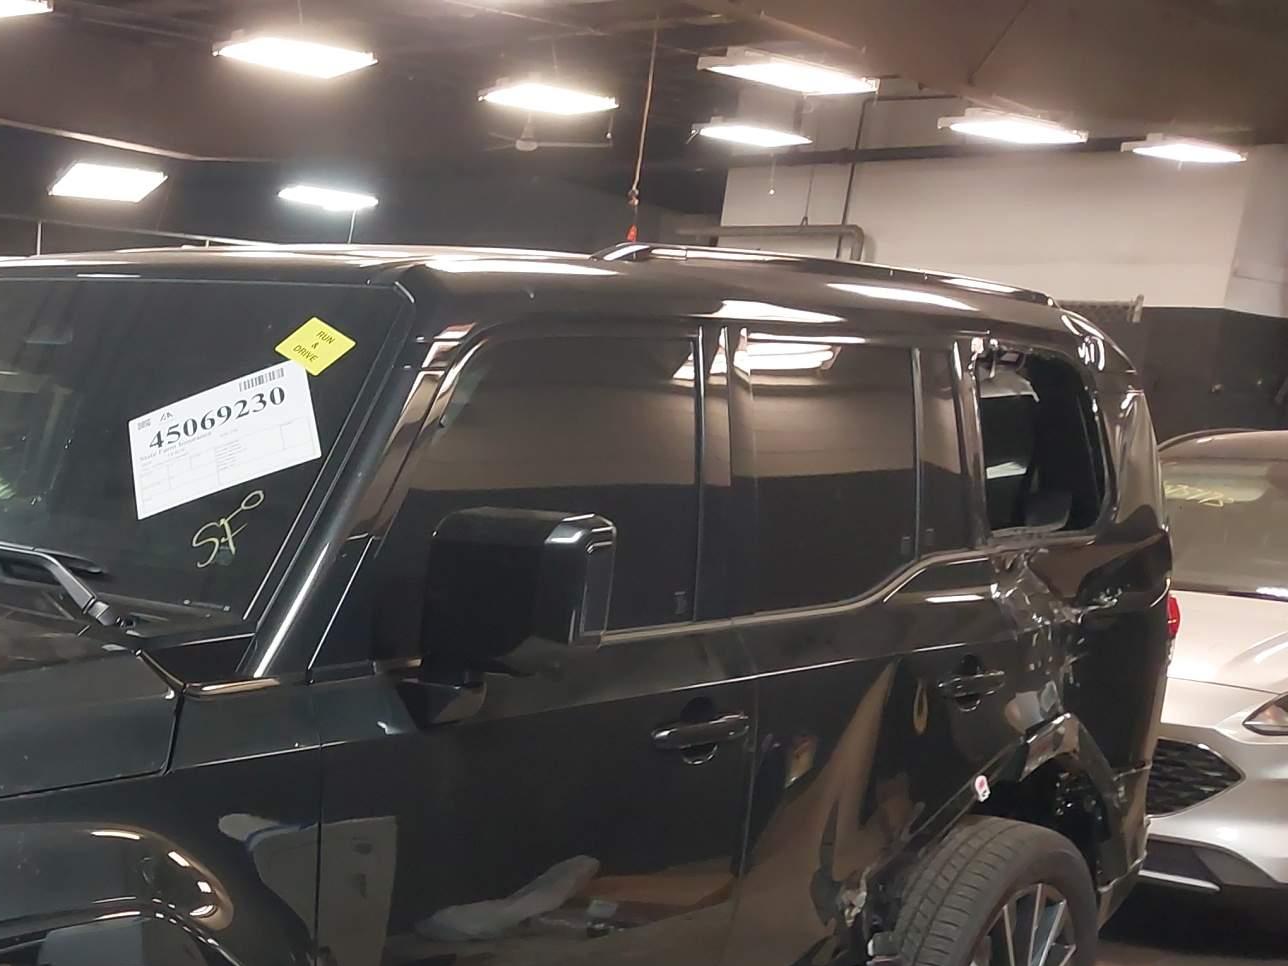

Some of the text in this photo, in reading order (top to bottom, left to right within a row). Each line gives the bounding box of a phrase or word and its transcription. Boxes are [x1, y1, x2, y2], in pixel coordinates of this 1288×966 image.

[311, 341, 318, 349] &
[315, 330, 335, 345] RUN
[293, 344, 319, 362] DRIVE
[149, 386, 286, 449] 45069230
